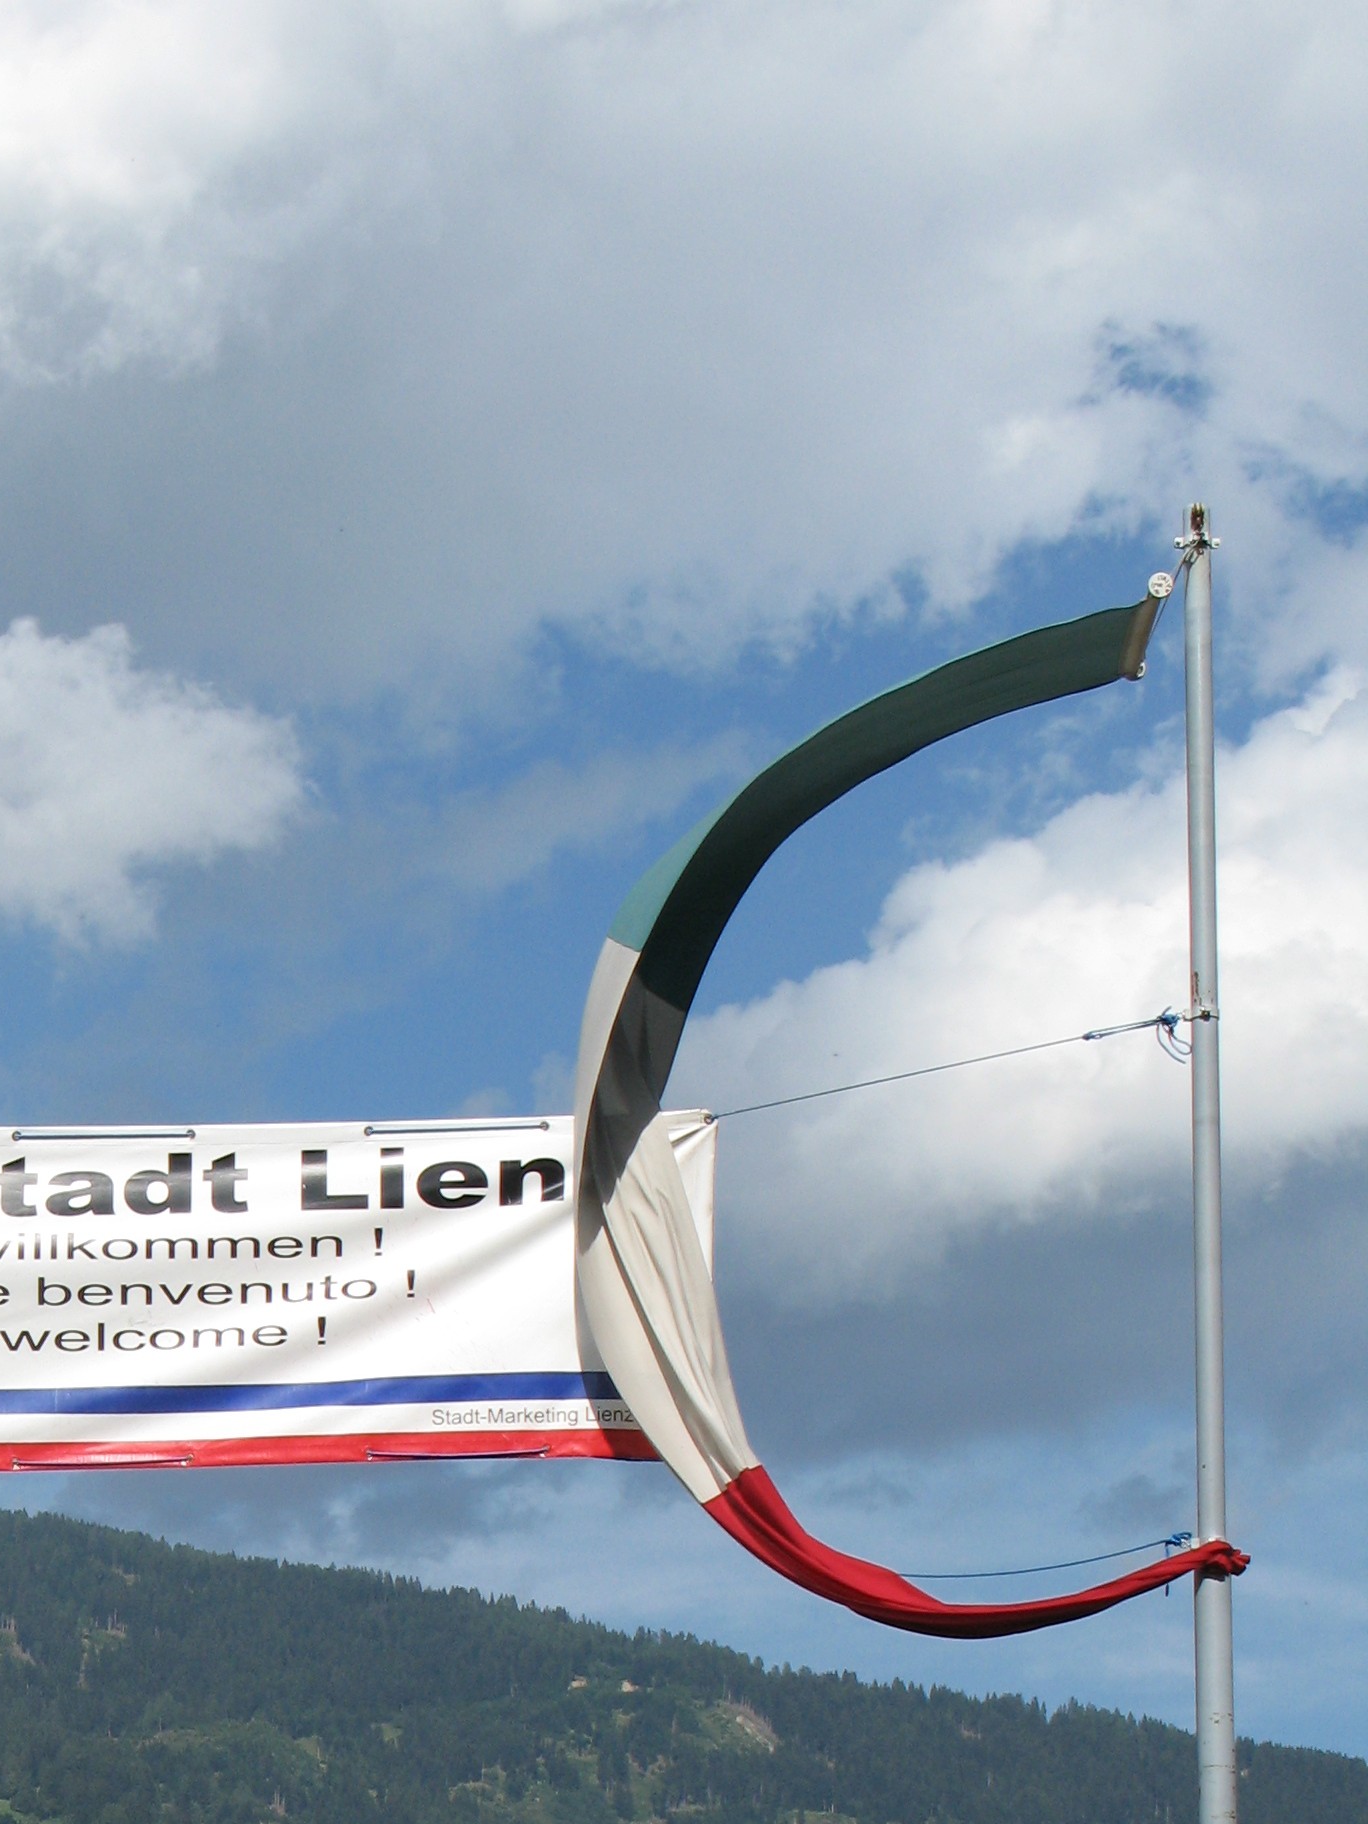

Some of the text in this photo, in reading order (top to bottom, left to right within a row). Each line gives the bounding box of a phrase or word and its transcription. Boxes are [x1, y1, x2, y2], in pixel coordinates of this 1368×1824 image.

[300, 1146, 567, 1211] Lien
[36, 1274, 378, 1307] benvenuto
[431, 1407, 634, 1427] Stadt-Marketing Lienz
